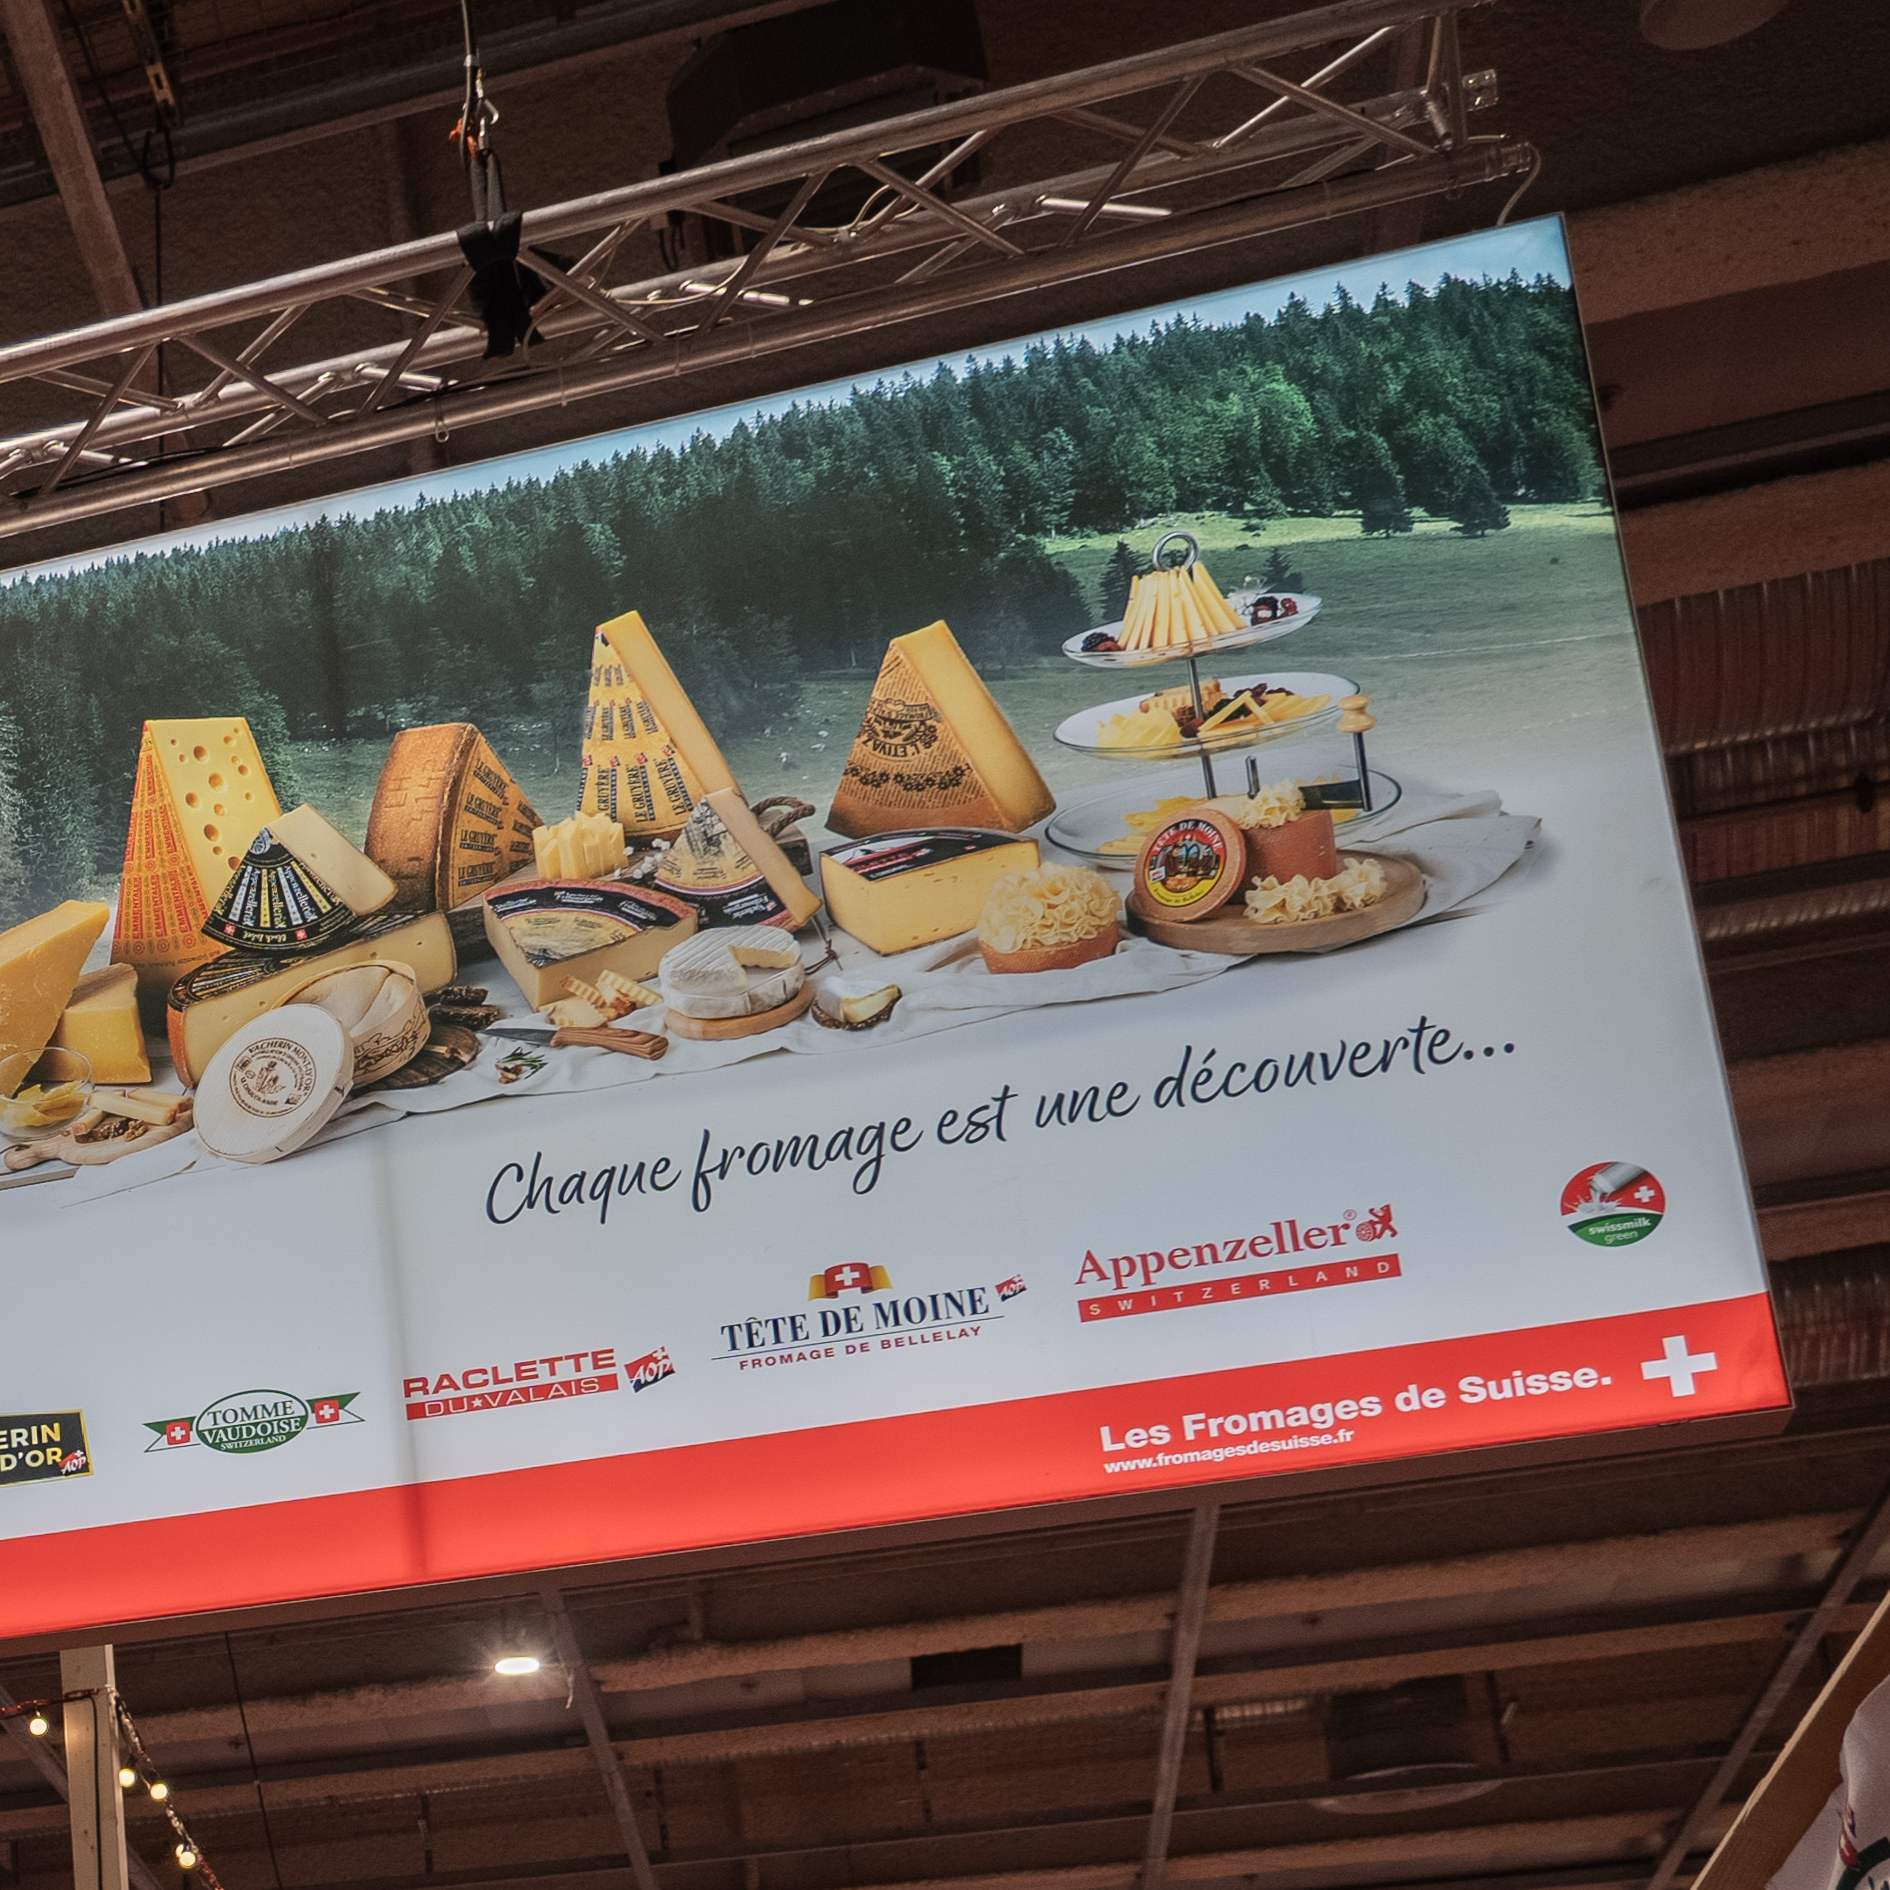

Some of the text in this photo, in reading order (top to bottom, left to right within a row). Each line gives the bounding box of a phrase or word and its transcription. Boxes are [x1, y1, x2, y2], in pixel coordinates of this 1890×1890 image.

[484, 1014, 1517, 1227] Chaque fromage est une découverte...
[1588, 1217, 1652, 1235] swissmilk
[1604, 1231, 1638, 1244] green
[1075, 1218, 1352, 1288] Appenzeller
[1088, 1261, 1392, 1317] SWITZERLAND
[721, 1287, 990, 1352] TÊTE DE MOINE
[739, 1325, 982, 1371] FROMAGE DE BELLELAY
[403, 1347, 617, 1399] RACLETTE
[202, 1417, 302, 1444] VAUDOISE
[207, 1400, 295, 1426] TOMME
[1100, 1366, 1613, 1453] Les Fromages de Suisse.
[220, 1434, 287, 1451] SWITZERLAND
[1103, 1427, 1356, 1475] www.fromagesdesuisse.fr
